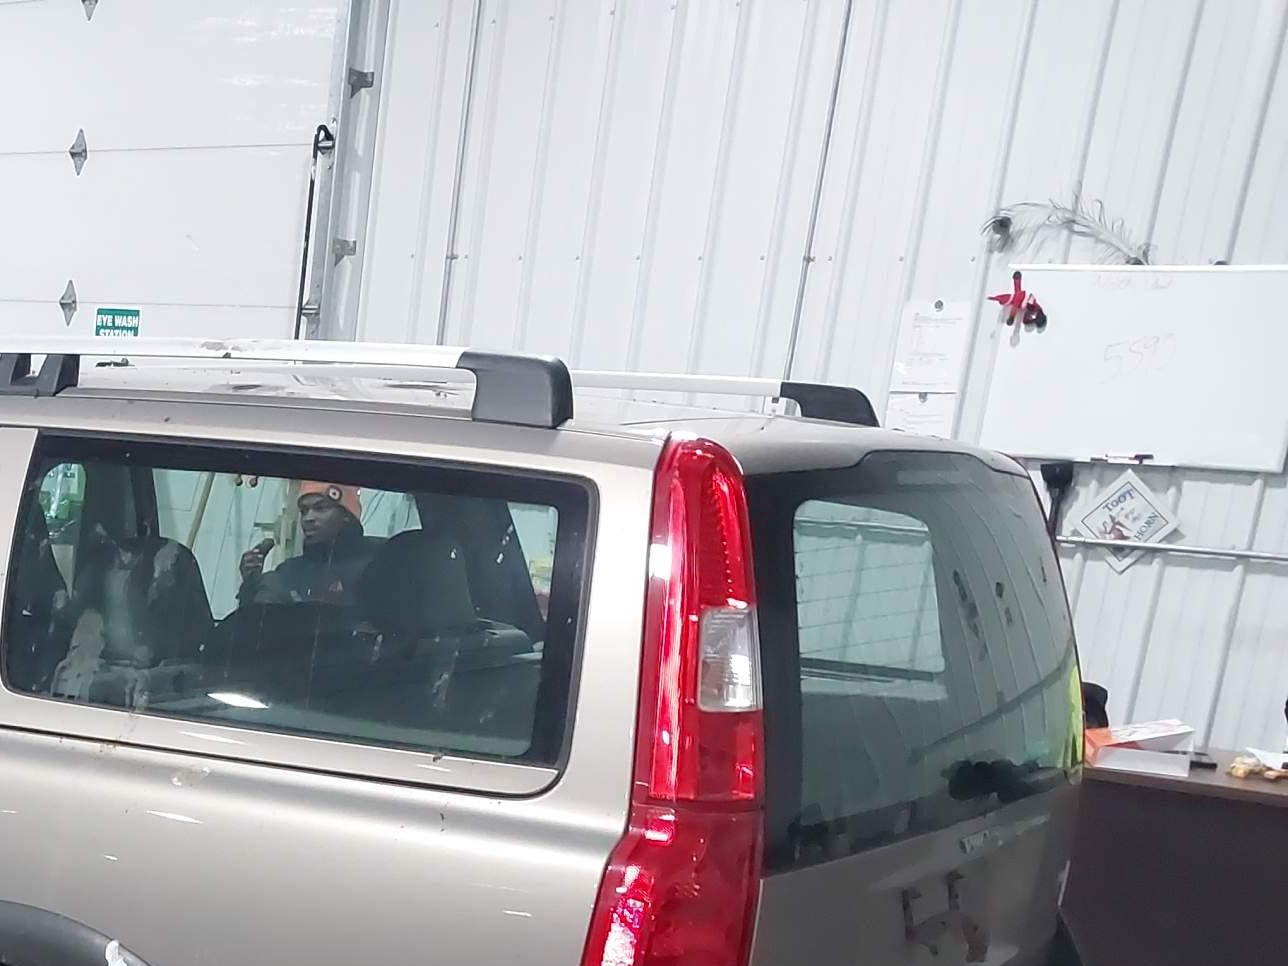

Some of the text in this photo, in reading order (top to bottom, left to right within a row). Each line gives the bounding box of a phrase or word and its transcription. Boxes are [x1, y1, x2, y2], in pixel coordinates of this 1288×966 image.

[97, 314, 139, 328] EYE WASH
[1133, 511, 1159, 541] HORN
